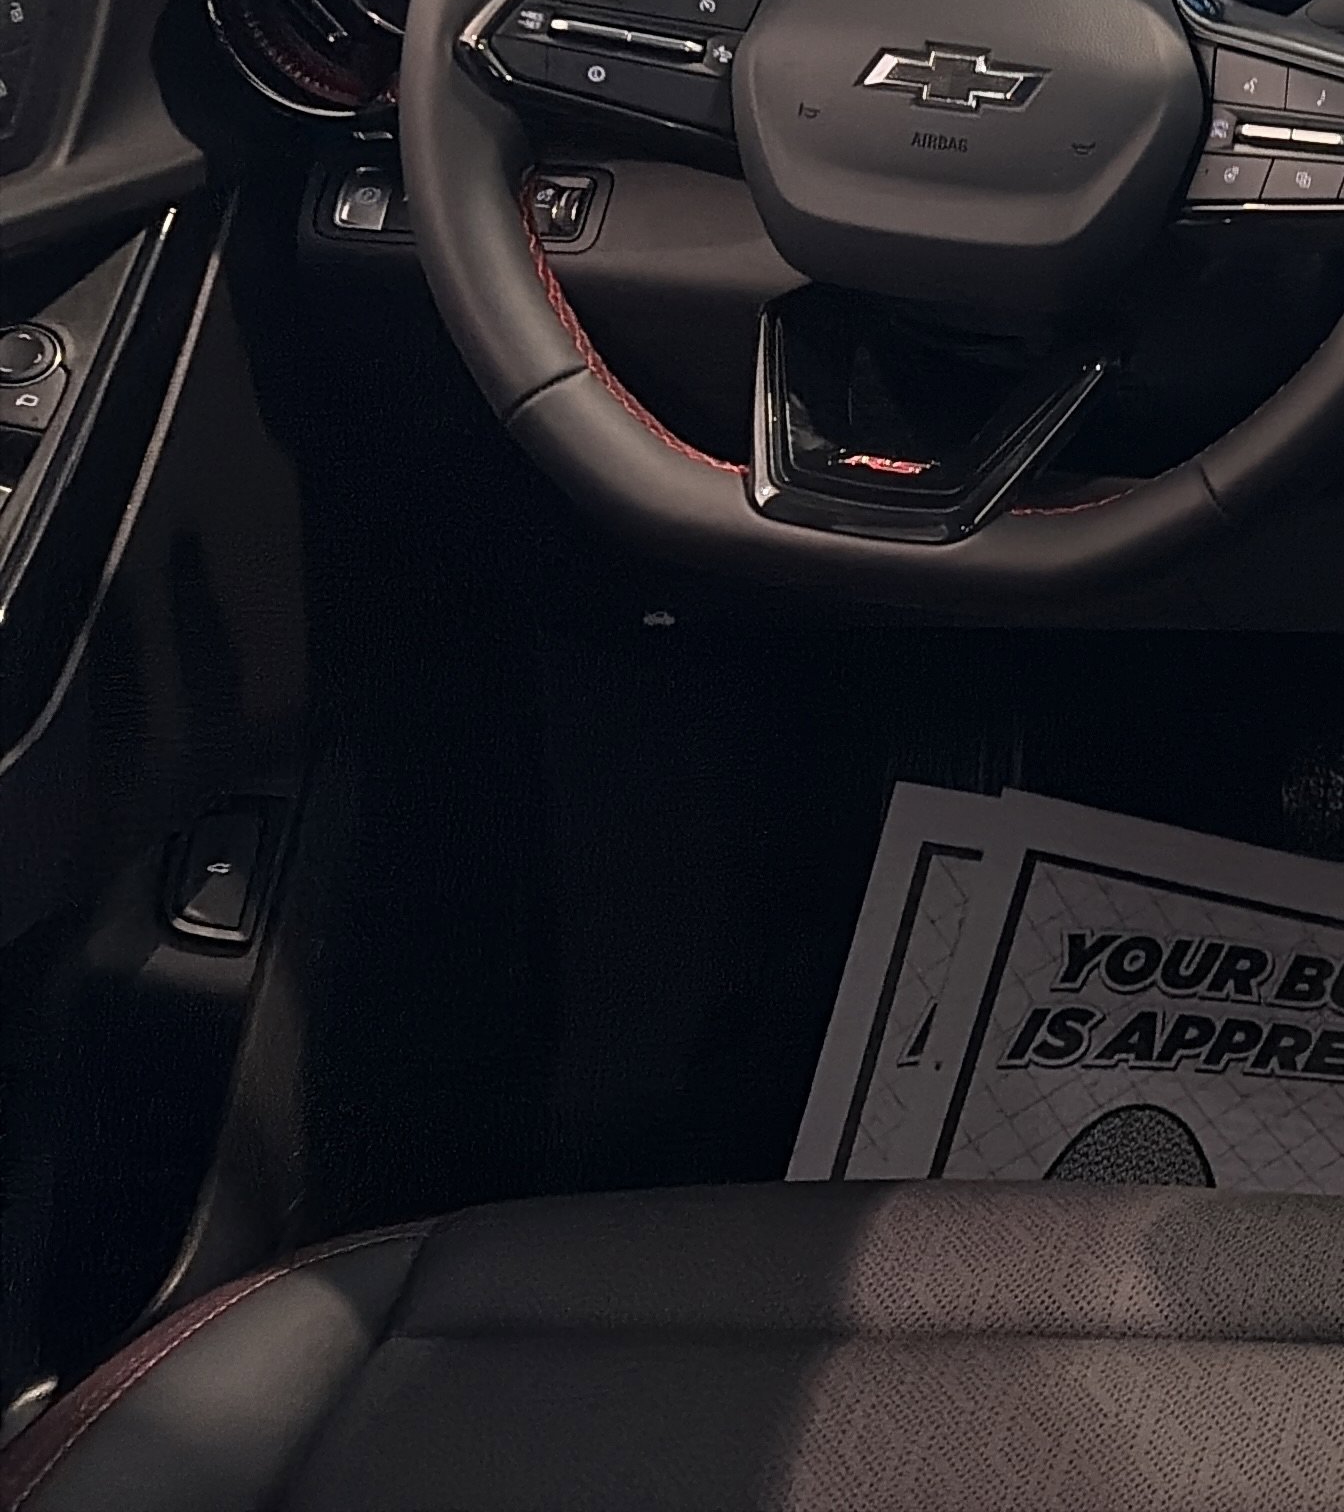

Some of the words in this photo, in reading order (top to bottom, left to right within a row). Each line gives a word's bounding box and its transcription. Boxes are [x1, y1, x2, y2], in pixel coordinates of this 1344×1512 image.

[911, 131, 968, 153] AIRBAG
[1052, 929, 1274, 1002] YOUR
[1003, 1004, 1105, 1066] IS
